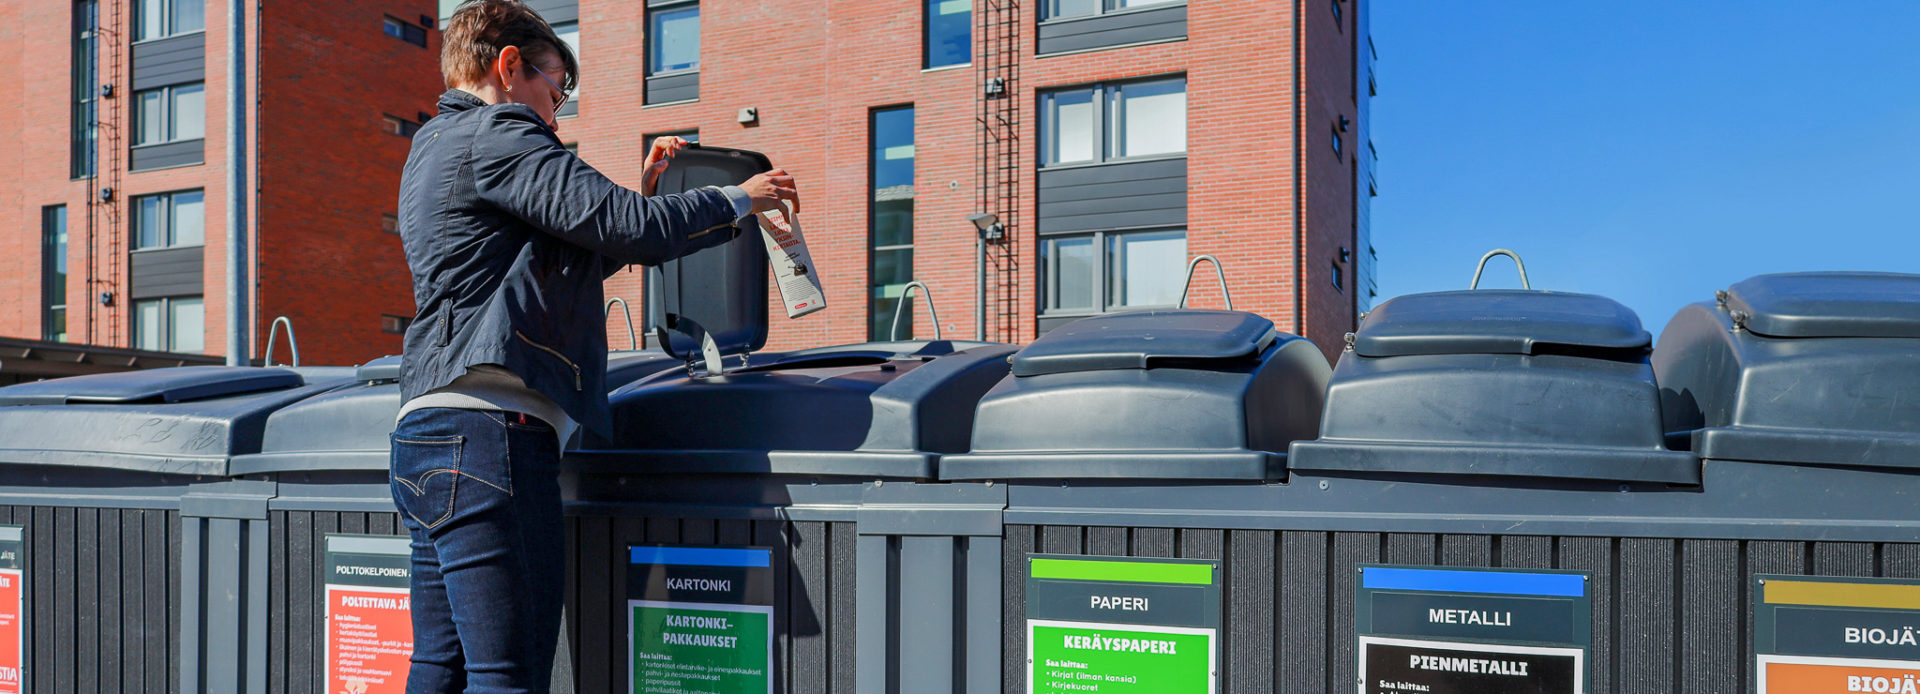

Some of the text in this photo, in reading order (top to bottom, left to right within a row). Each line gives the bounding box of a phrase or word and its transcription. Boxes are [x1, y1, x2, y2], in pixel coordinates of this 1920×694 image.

[1, 551, 15, 560] JÄTE
[336, 565, 407, 577] POLTTOKELPOINEN
[666, 578, 731, 591] KARTONKI
[342, 596, 396, 609] POLTETTAVA
[1090, 596, 1149, 611] PAPERI
[666, 615, 734, 629] KARTONKI-
[1429, 608, 1511, 627] METALLI
[663, 633, 738, 648] PAKKAUKSET
[1845, 626, 1920, 646] BIOJÄ
[1063, 634, 1177, 655] KERÄYSPAPERI
[651, 652, 673, 661] laittaa:
[645, 661, 676, 669] kartonkiset
[1046, 659, 1089, 669] Saa laittaa:
[1410, 655, 1528, 676] PIENMETALLI
[1051, 670, 1137, 684] Kirjat (ilman kansia)
[1051, 680, 1098, 691] Kirjekuoret
[1379, 680, 1430, 692] Saa laittaa:
[1848, 674, 1920, 694] BIOJÄ
